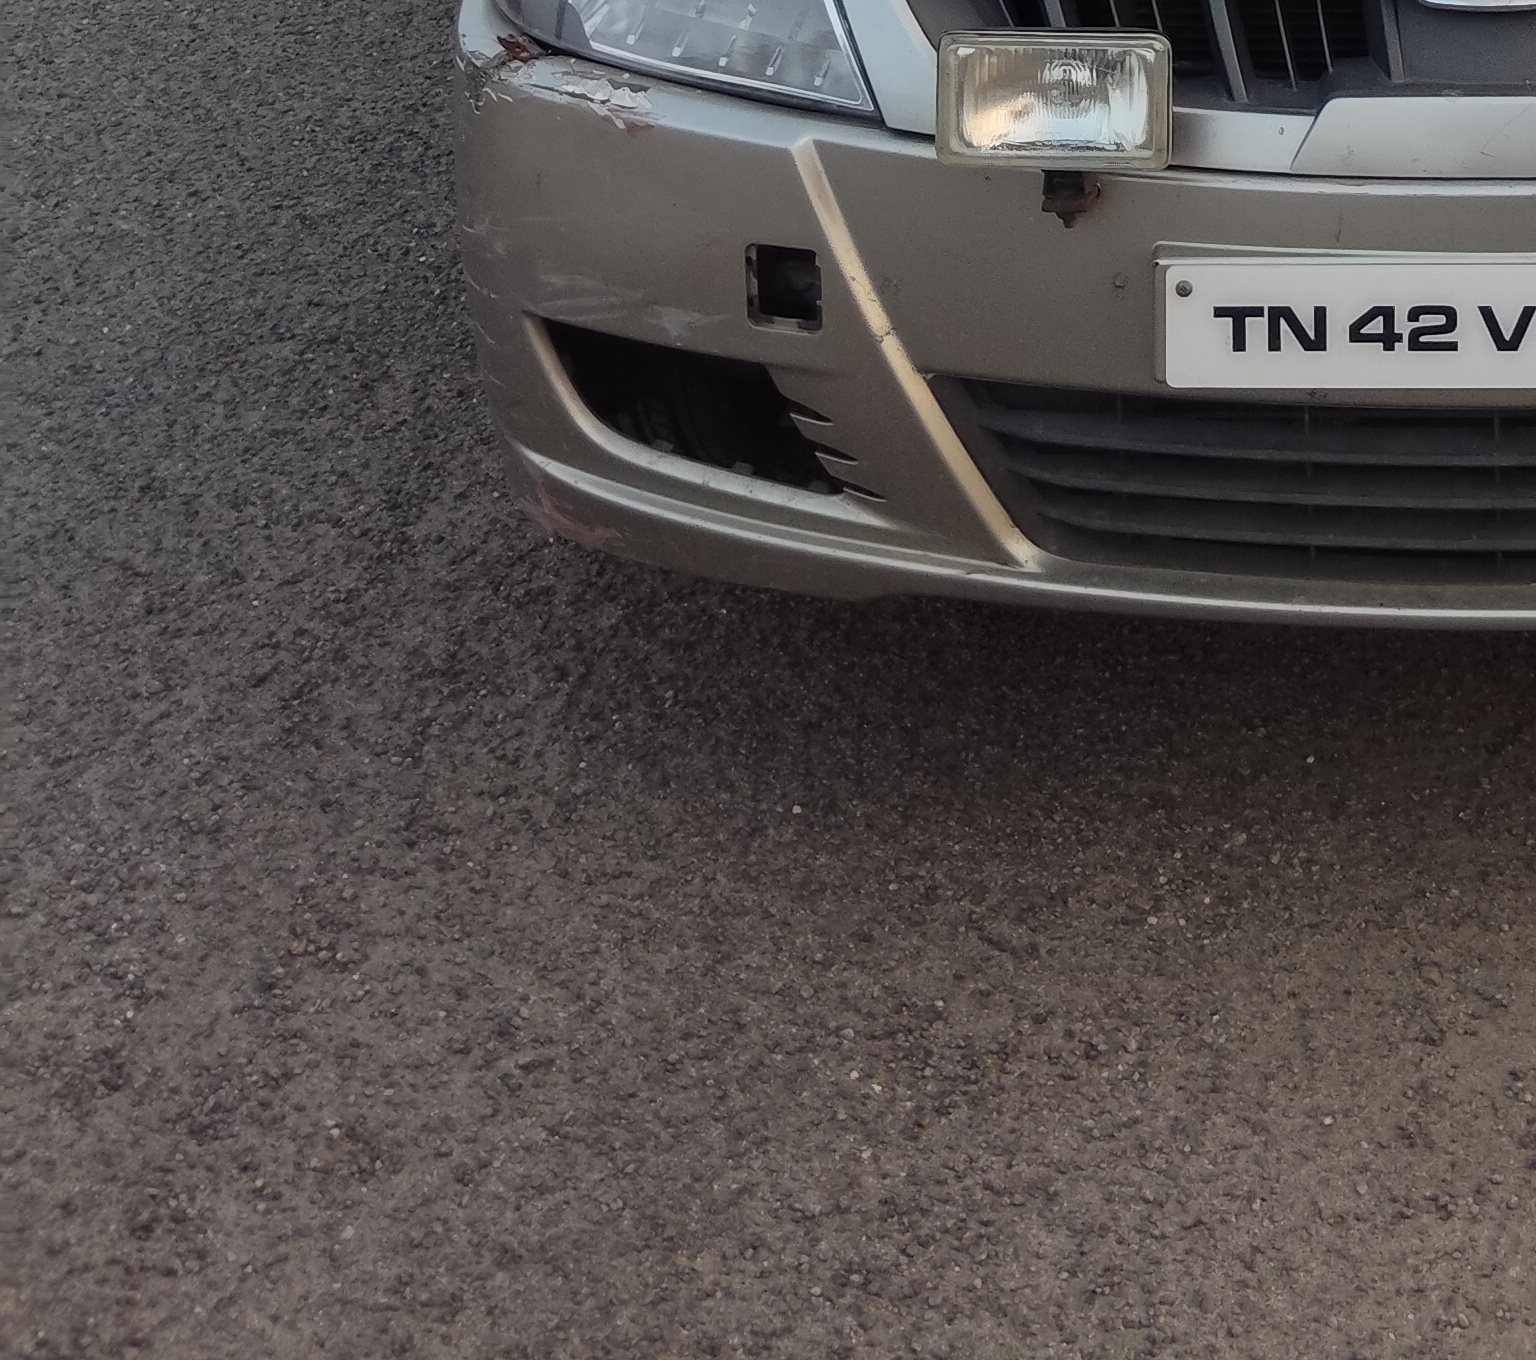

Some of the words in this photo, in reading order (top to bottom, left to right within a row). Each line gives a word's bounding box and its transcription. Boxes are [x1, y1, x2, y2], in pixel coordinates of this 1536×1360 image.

[1213, 305, 1328, 353] TN
[1348, 305, 1459, 353] 42
[1478, 305, 1536, 353] V
